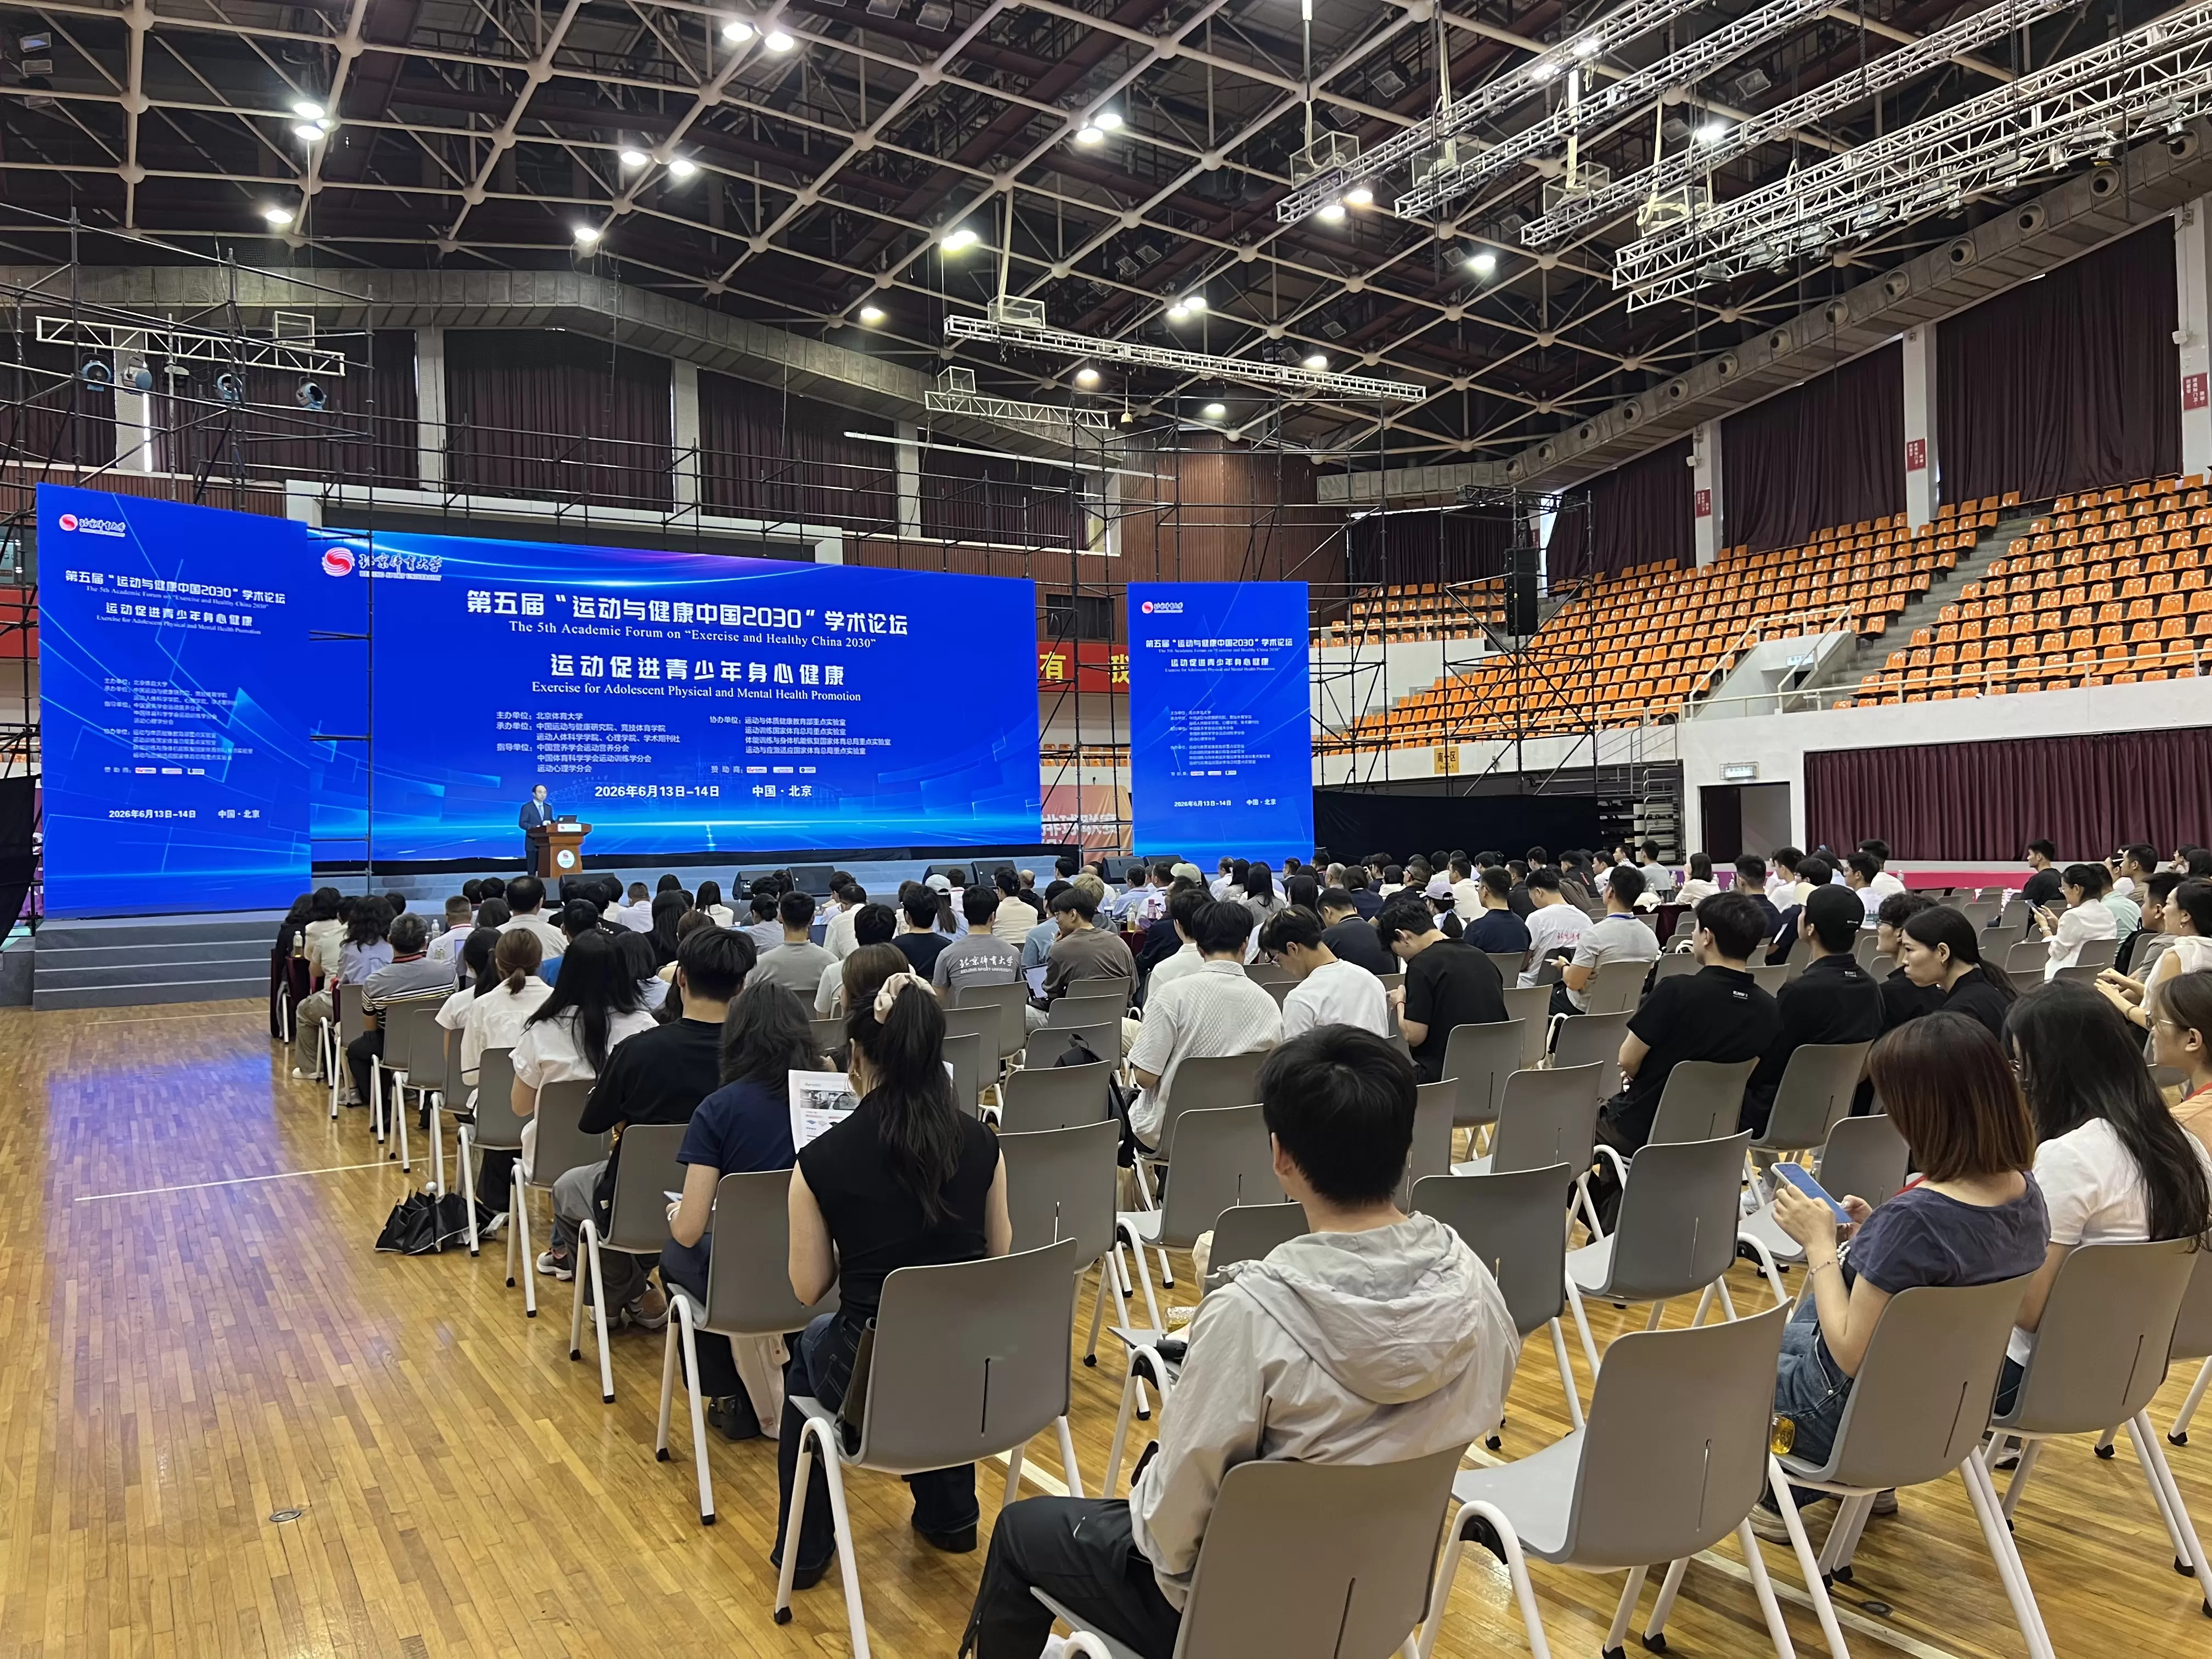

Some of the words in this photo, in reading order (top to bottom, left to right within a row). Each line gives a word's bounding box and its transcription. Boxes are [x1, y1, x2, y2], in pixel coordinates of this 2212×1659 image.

[509, 620, 533, 633] The
[537, 622, 556, 633] 5th
[561, 624, 621, 636] Academic
[625, 626, 663, 638] Forum
[667, 630, 681, 639] on
[743, 633, 763, 643] and
[766, 634, 808, 647] Healthy
[811, 636, 842, 647] China
[550, 653, 844, 686] 运动促进青少年身心健康
[532, 682, 581, 693] Exercise
[584, 682, 601, 693] for
[604, 684, 665, 695] Adolescent
[668, 685, 712, 698] Physical
[715, 687, 733, 698] and
[737, 688, 772, 699] Mental
[776, 689, 808, 700] Health
[811, 691, 861, 702] Promotion
